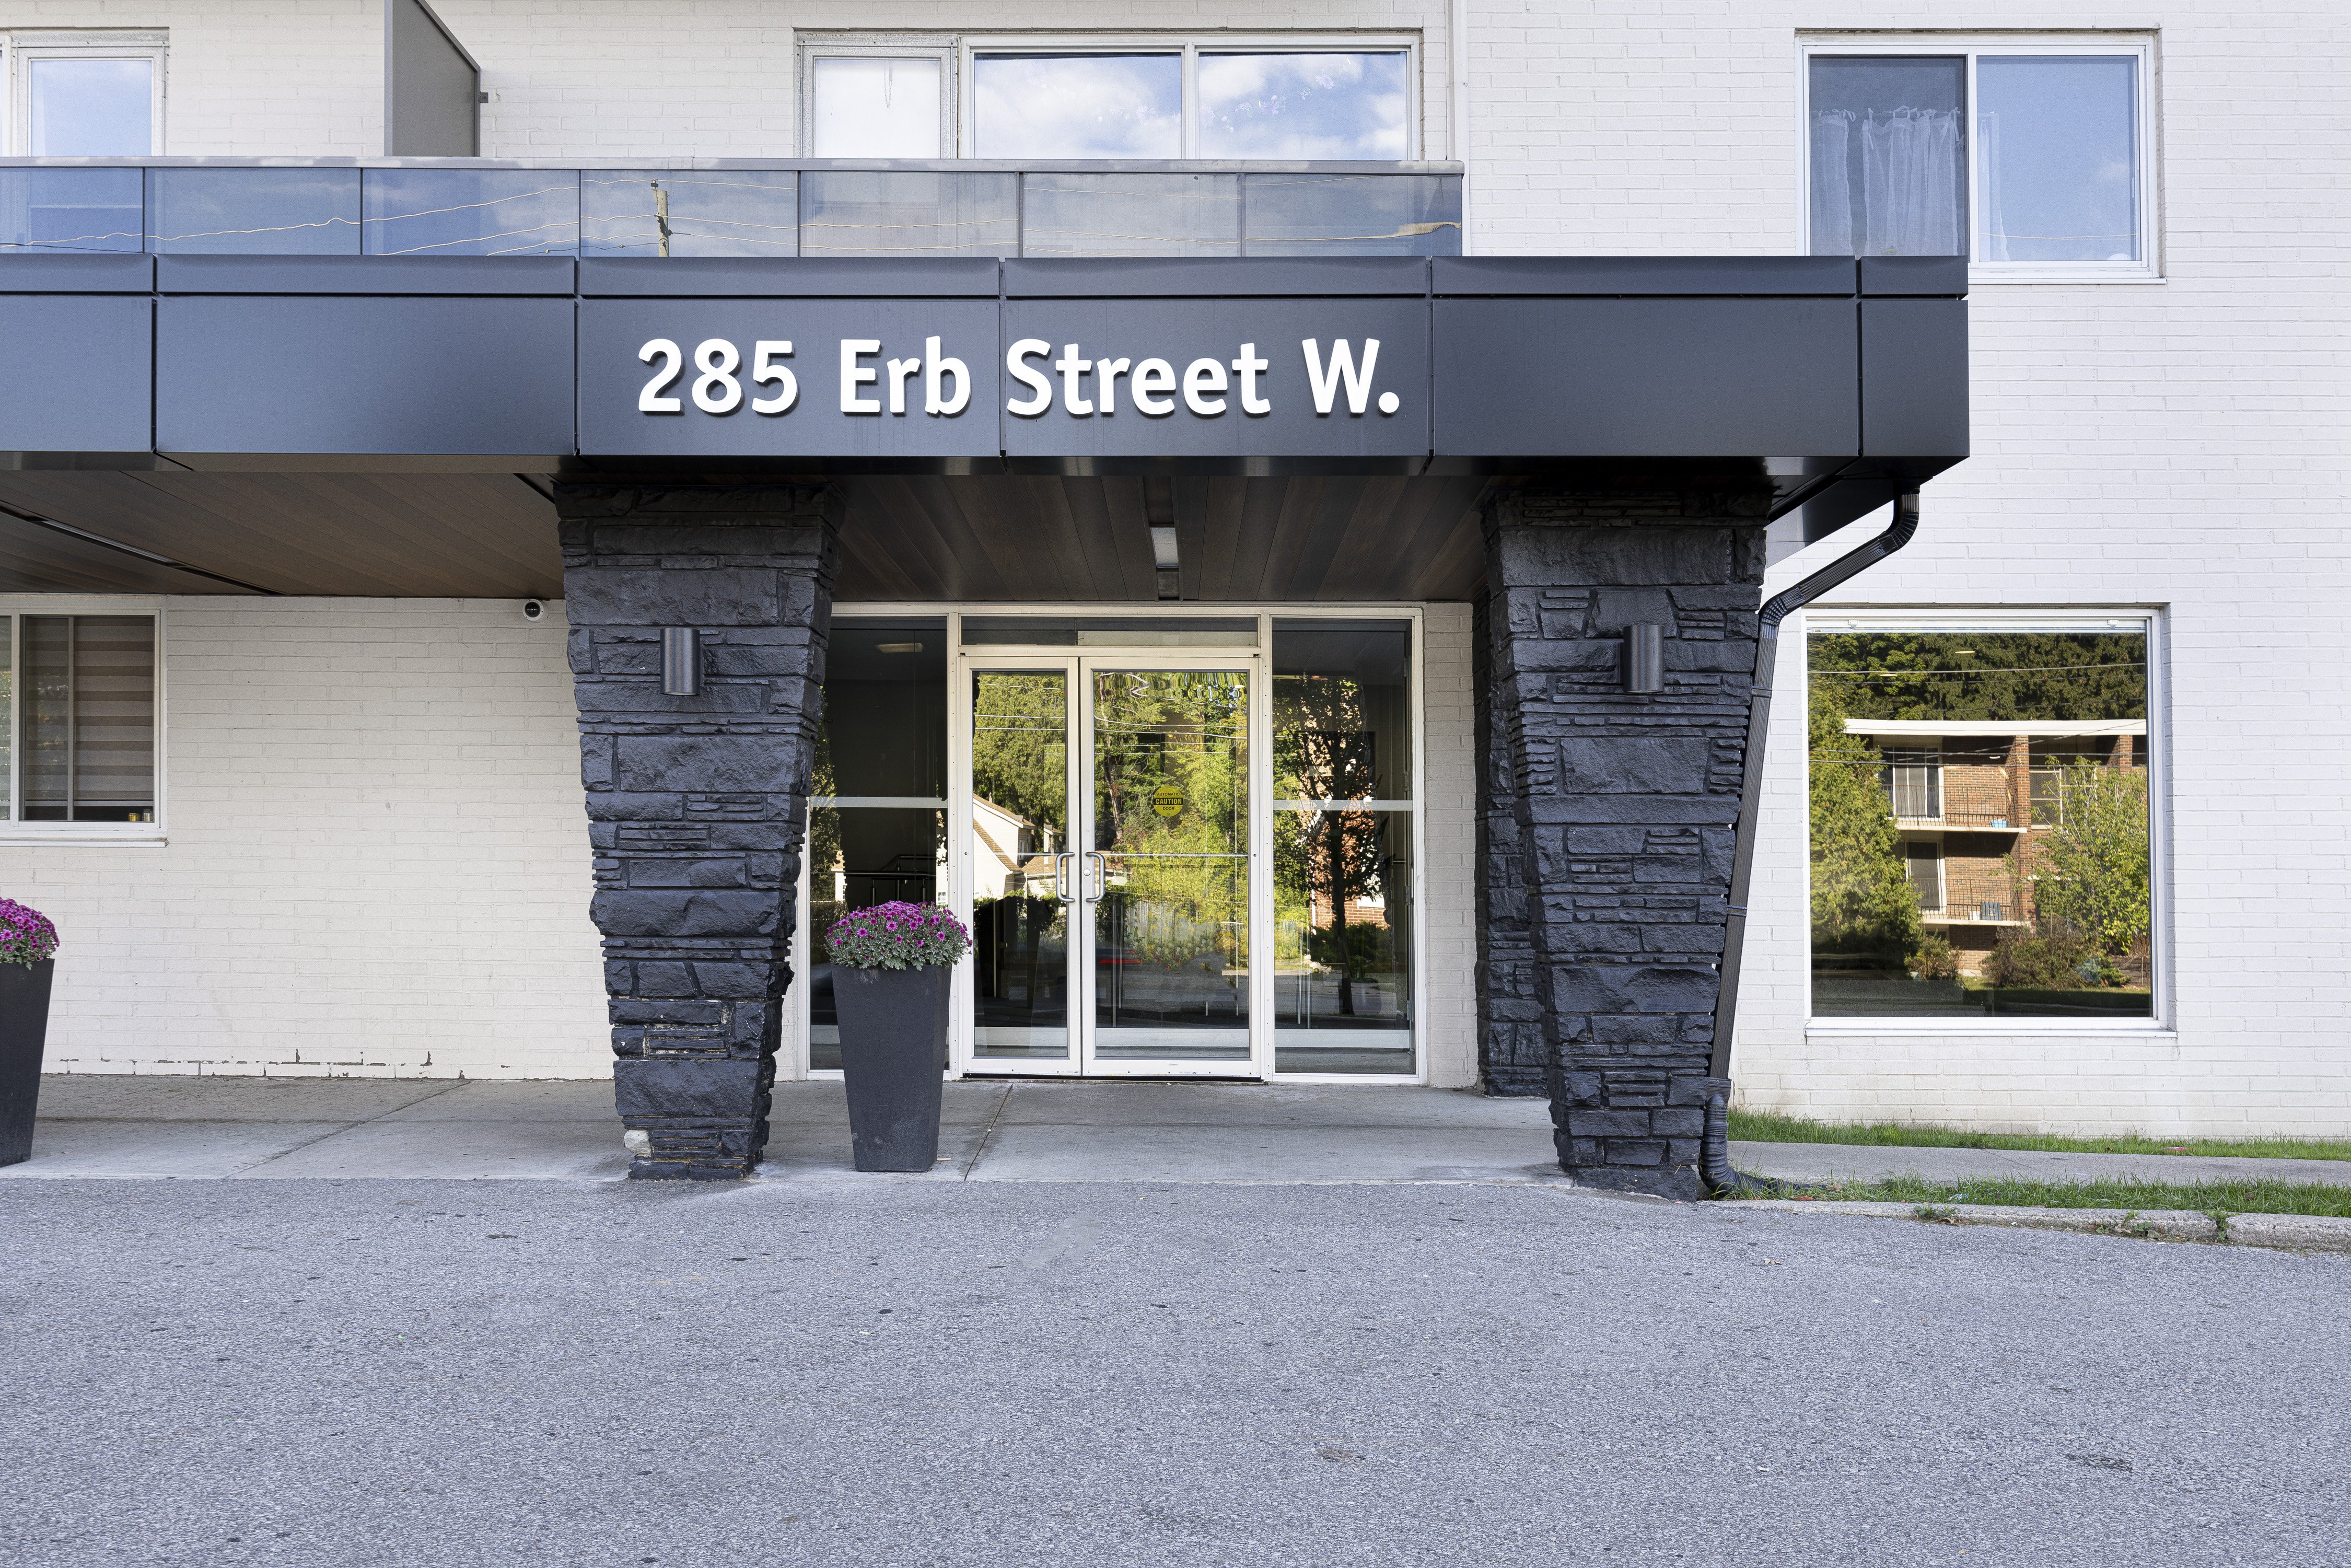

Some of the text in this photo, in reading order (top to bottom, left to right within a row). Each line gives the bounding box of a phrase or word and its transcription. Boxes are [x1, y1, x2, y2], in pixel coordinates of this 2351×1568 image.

[638, 335, 1400, 415] 285 Erb Street W.
